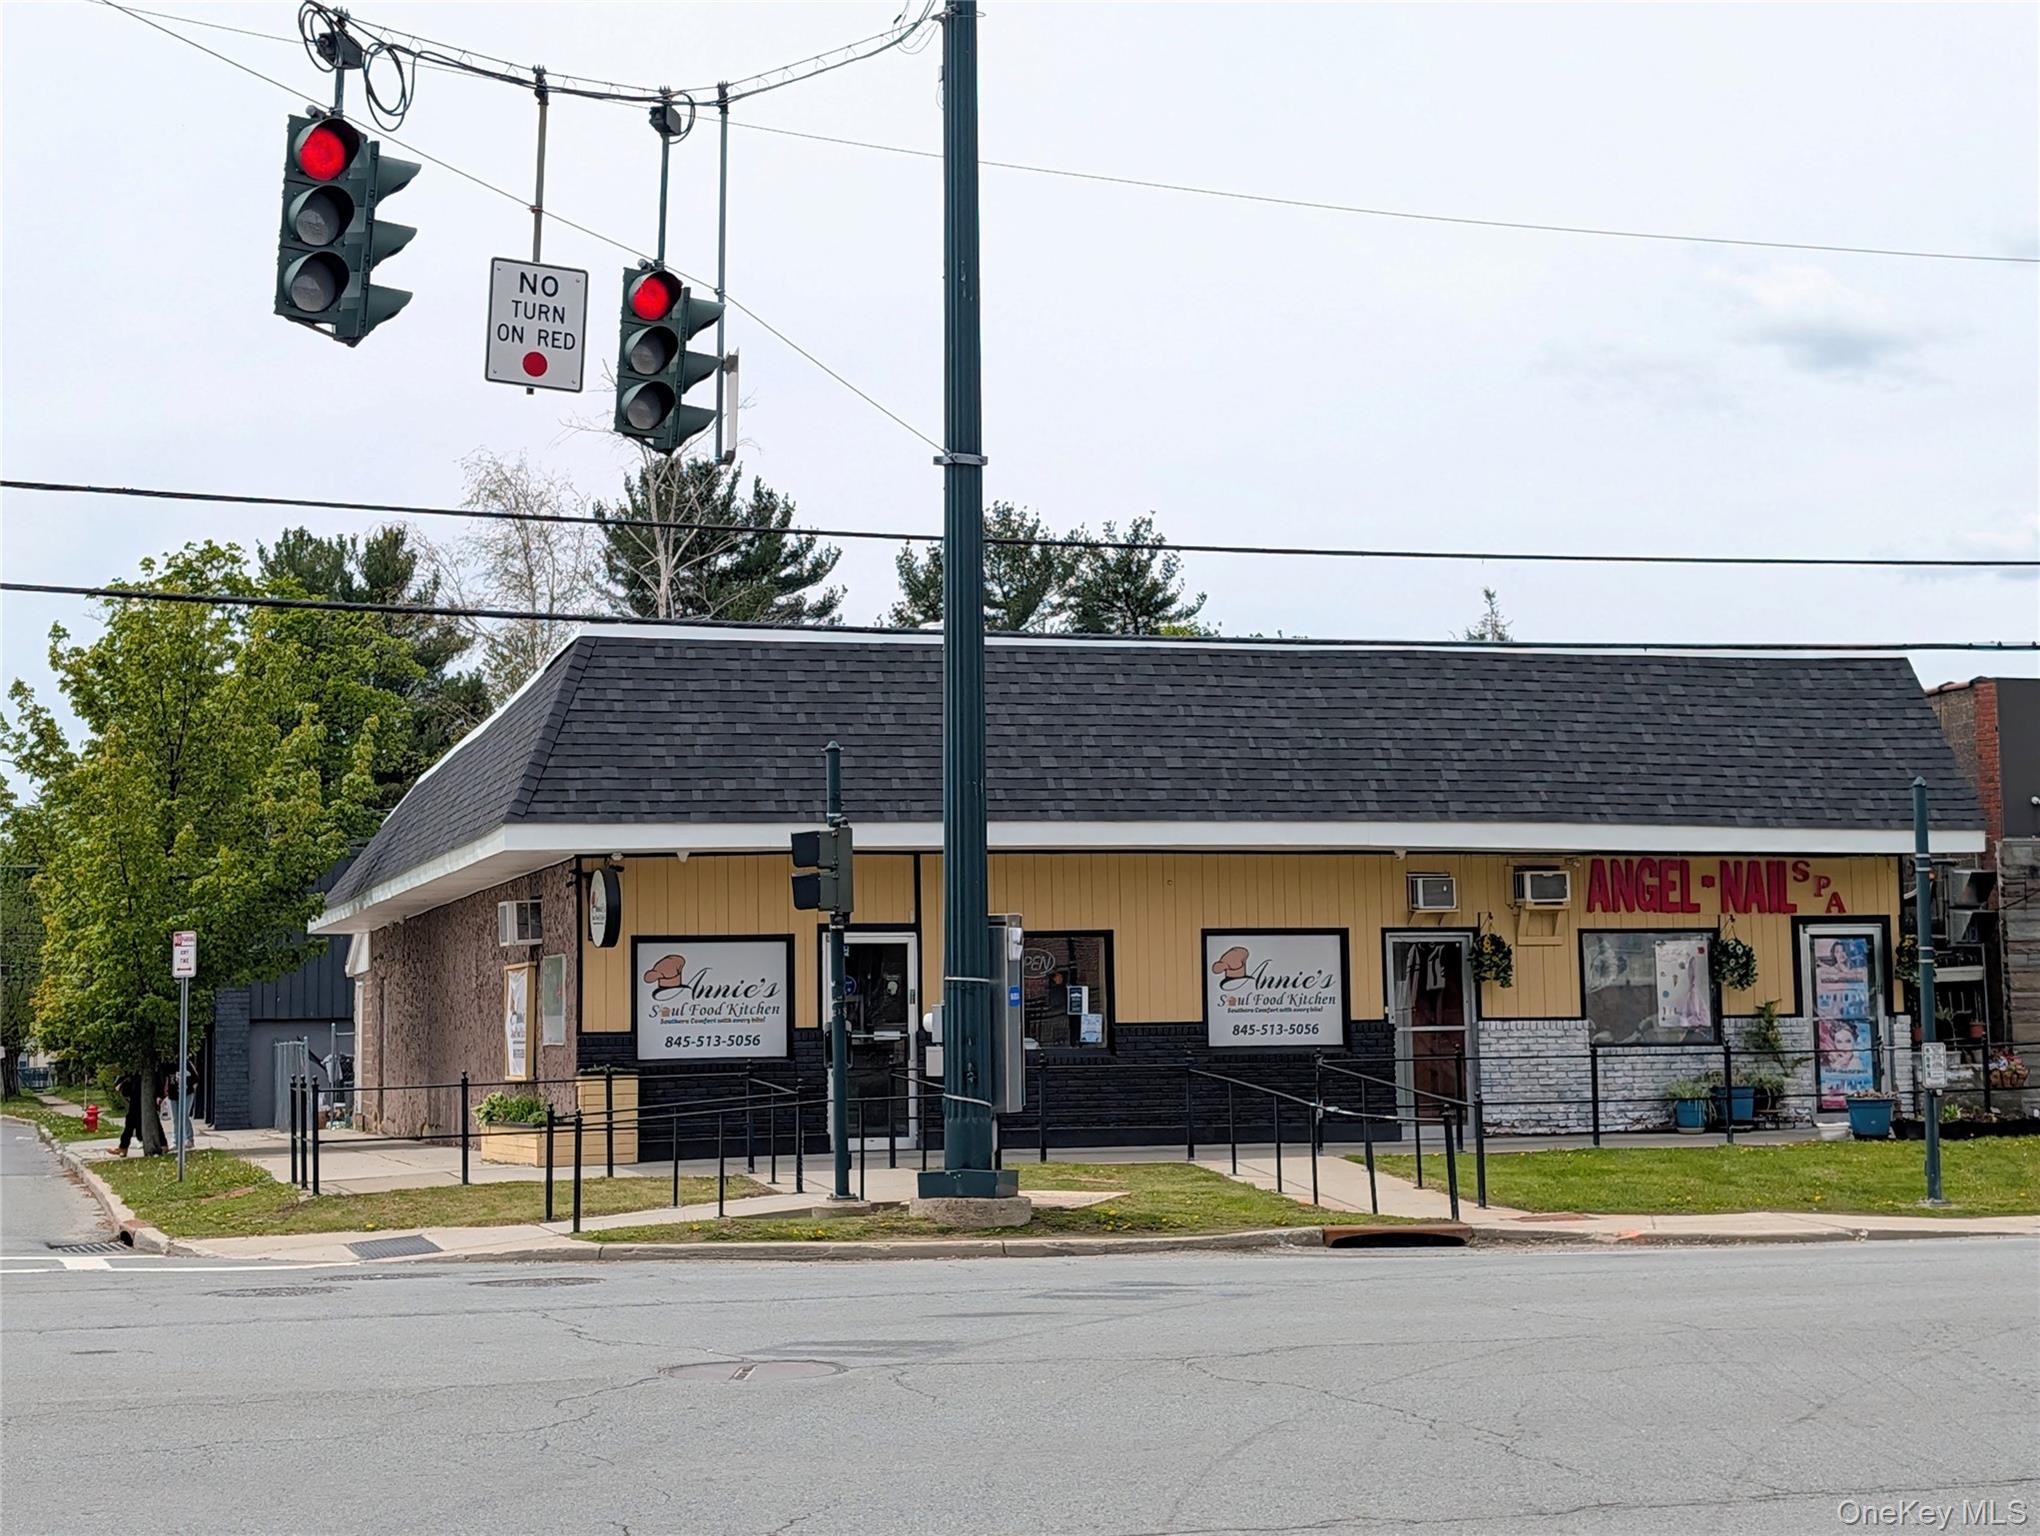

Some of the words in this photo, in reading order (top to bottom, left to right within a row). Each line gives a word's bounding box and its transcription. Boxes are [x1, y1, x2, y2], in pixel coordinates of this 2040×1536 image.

[519, 272, 559, 297] NO
[511, 300, 565, 324] TURN
[497, 323, 524, 344] ON
[537, 329, 576, 350] RED
[1586, 858, 1702, 914] ANGEL
[1719, 859, 1797, 914] NAIL
[1791, 860, 1847, 914] SPA
[1024, 955, 1051, 971] PEN
[1219, 959, 1336, 991] Annie's
[652, 967, 780, 1001] Annie's
[688, 1001, 724, 1016] Food
[726, 1001, 780, 1019] Kitchen
[1253, 991, 1287, 1007] Food
[1287, 992, 1336, 1009] Kitchen
[664, 1034, 761, 1049] 845-513-5056
[1231, 1023, 1320, 1037] 845-513-5056
